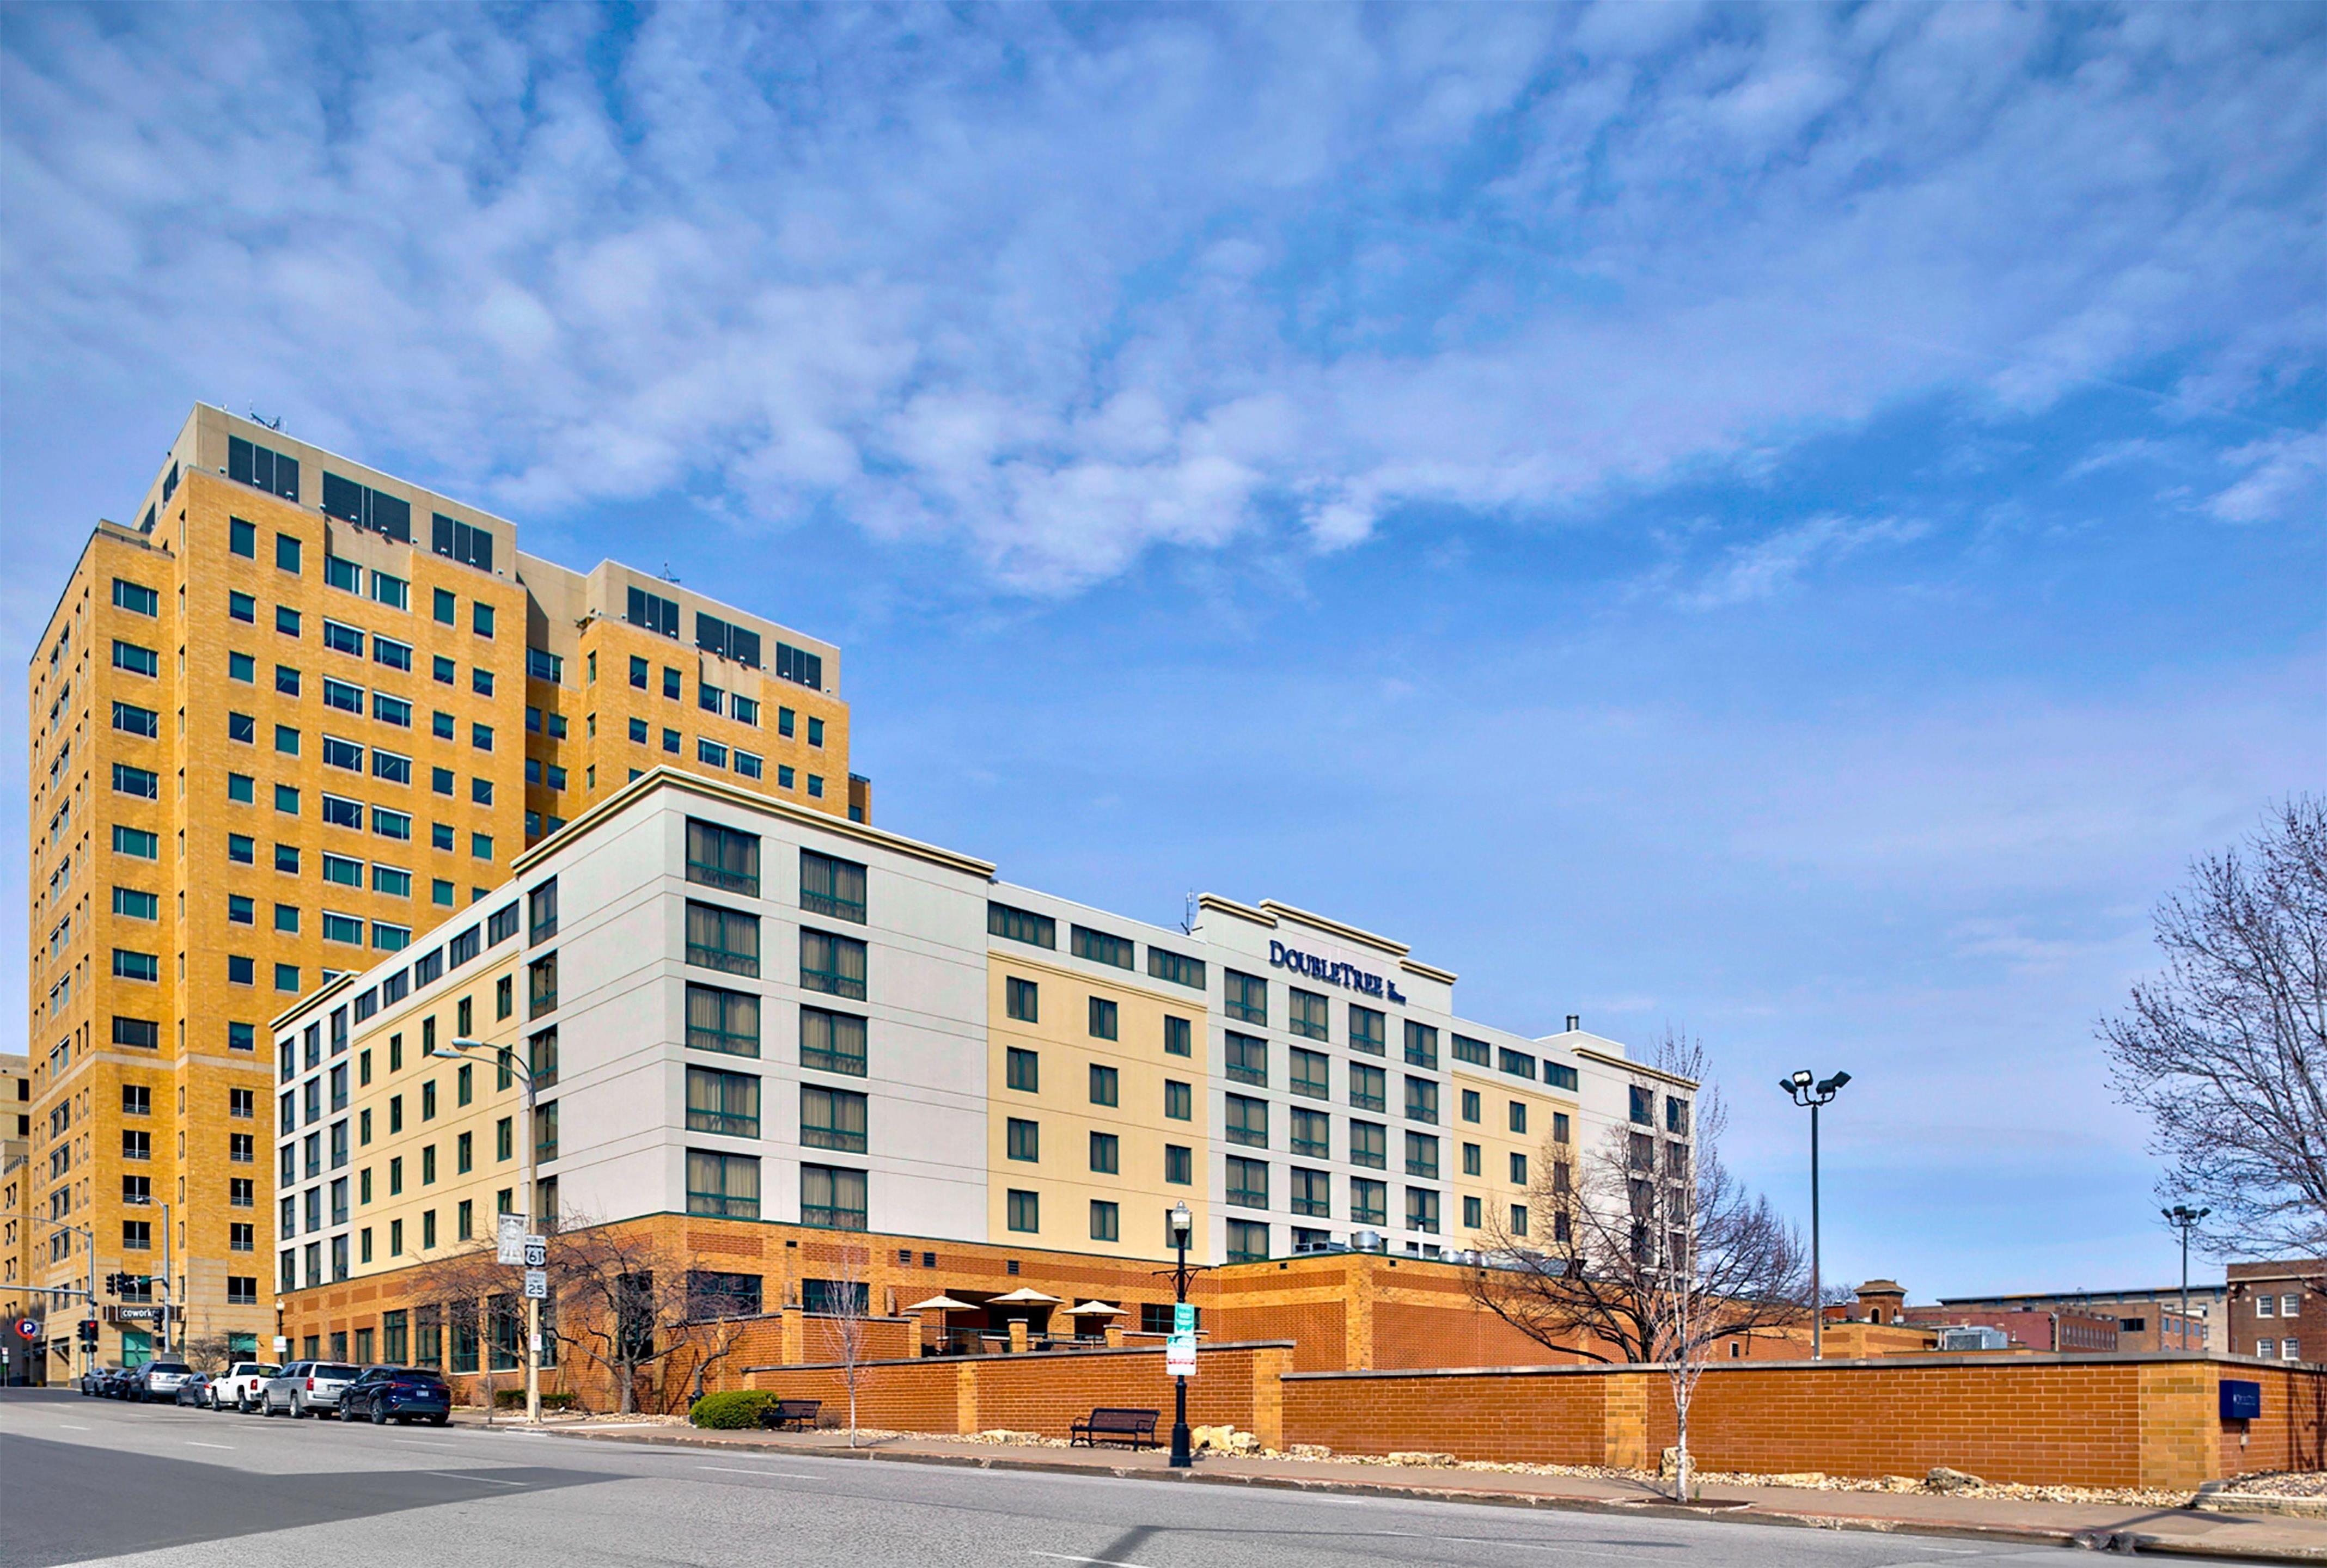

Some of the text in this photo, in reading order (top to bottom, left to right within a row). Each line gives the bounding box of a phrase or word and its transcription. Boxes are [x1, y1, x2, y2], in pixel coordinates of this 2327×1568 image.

[529, 1251, 542, 1262] 61
[528, 1284, 544, 1295] 25
[23, 1324, 33, 1333] P
